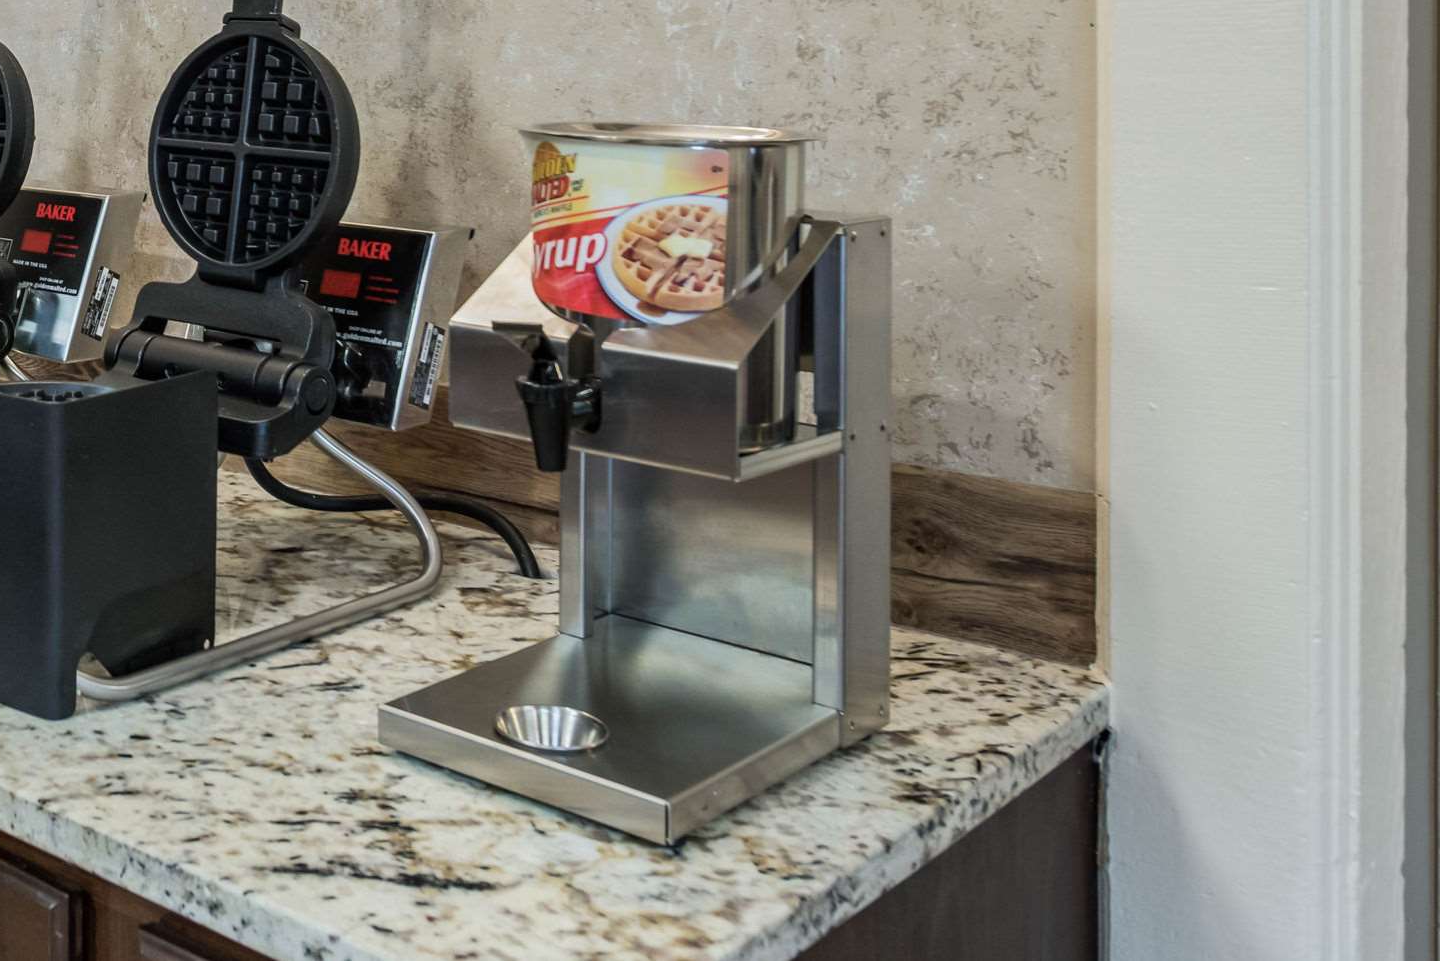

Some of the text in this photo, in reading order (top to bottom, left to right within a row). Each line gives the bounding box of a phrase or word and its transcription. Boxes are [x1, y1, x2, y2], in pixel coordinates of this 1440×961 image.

[36, 202, 77, 222] BAKER
[337, 237, 392, 261] BAKER
[533, 232, 607, 280] yrup
